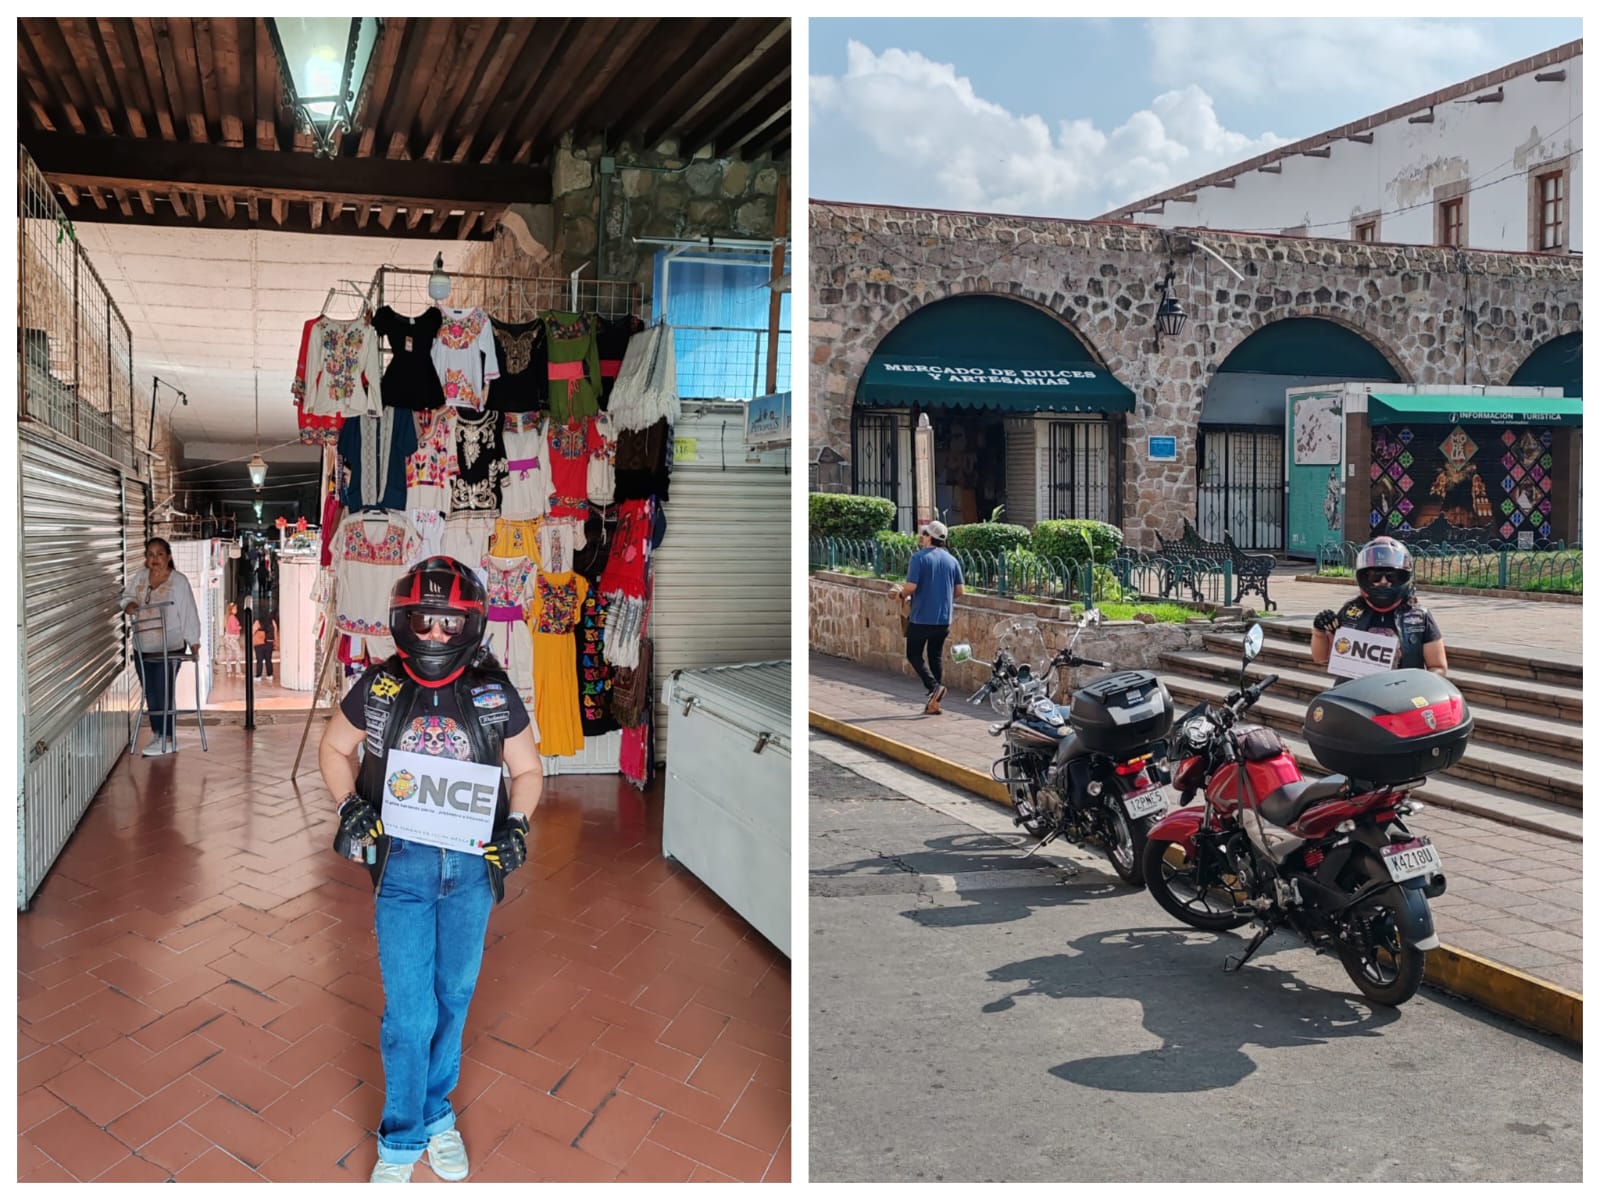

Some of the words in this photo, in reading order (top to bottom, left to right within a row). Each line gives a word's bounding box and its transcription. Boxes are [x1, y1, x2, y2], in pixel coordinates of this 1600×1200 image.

[883, 363, 984, 376] MERCADO
[988, 367, 1017, 377] DE
[1021, 369, 1096, 379] DULCES
[927, 373, 942, 381] Y
[949, 375, 1070, 386] ARTESANIAS
[1391, 847, 1433, 873] K4Z18U
